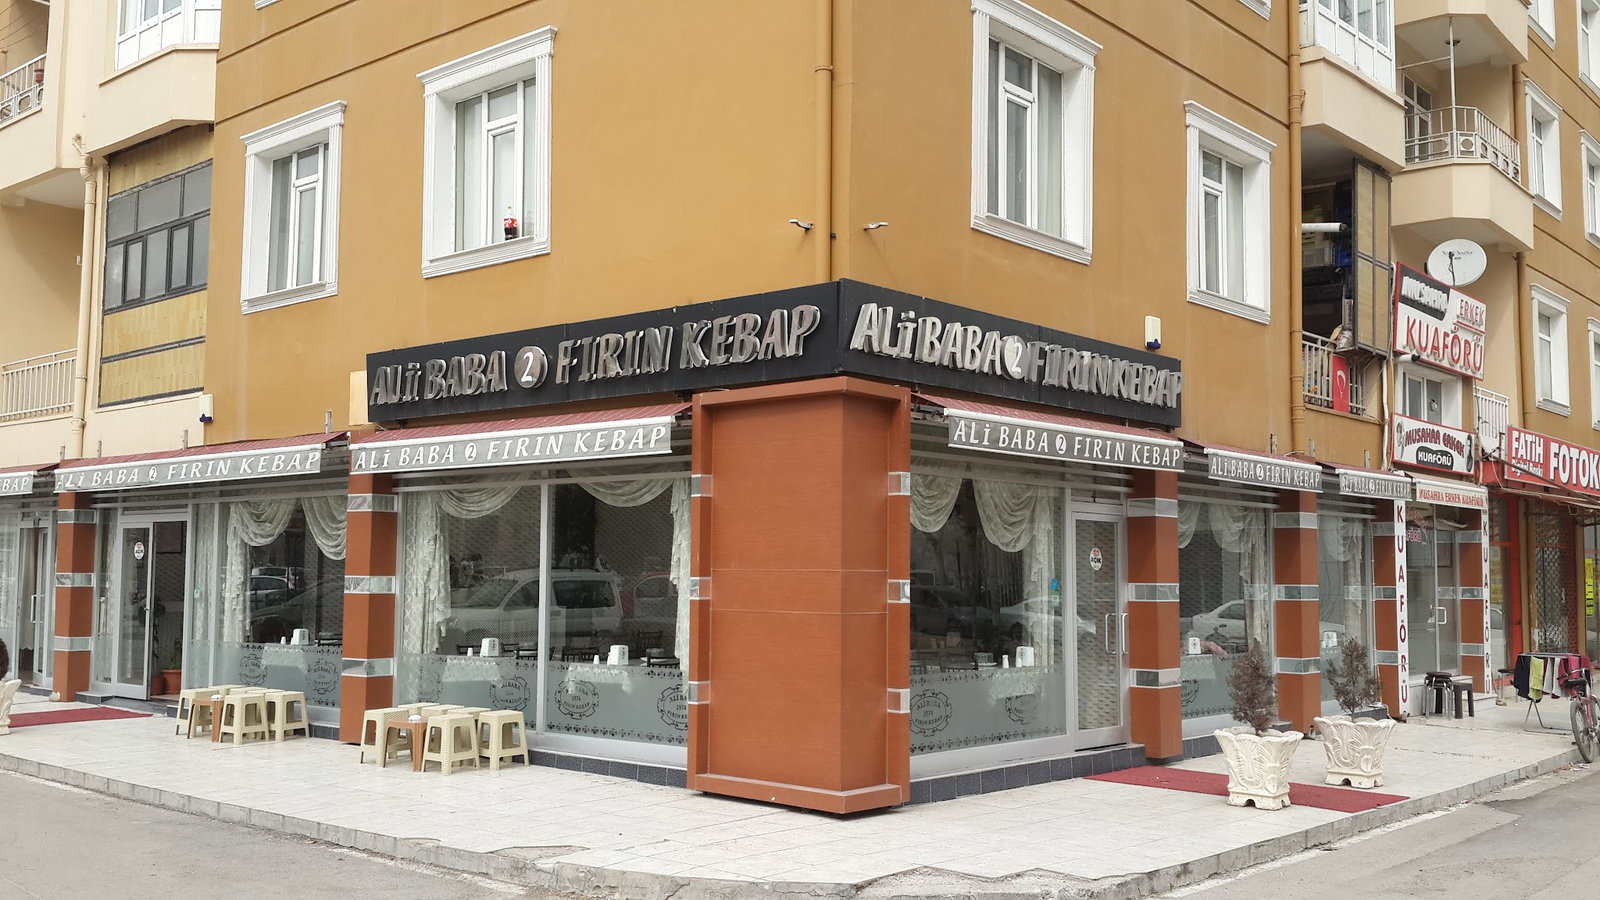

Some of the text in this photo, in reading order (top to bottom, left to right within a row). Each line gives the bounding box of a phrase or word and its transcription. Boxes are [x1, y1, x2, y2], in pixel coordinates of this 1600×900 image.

[1459, 299, 1485, 323] ERKEK
[424, 350, 507, 398] BABA
[555, 325, 673, 384] FIRIN
[679, 304, 821, 369] KEBAP
[914, 316, 1001, 376] BABA
[1024, 340, 1112, 396] FIRIN
[1108, 356, 1185, 409] KEBAP
[1406, 315, 1483, 372] KUAFÖRÜ
[398, 444, 454, 467] BABA
[487, 433, 564, 460] FIRIN
[574, 426, 667, 453] KEBAP
[998, 426, 1049, 453] BABA
[1073, 436, 1125, 461] FIRIN
[1131, 444, 1181, 467] KEBAP
[1405, 427, 1441, 447] MUSAHRA
[91, 468, 139, 486] BABA
[149, 467, 158, 481] 2
[167, 458, 233, 480] FIRIN
[238, 451, 322, 475] KEBAP
[1230, 461, 1255, 479] BABA
[1265, 466, 1292, 484] FIRIN
[1293, 470, 1320, 488] KEBAP
[1418, 451, 1452, 466] KUAFÖRÜ
[1549, 441, 1600, 490] FOTOK
[0, 477, 29, 492] BAP
[1396, 505, 1409, 704] KUAFÖRÜ
[1483, 521, 1491, 694] KUAFÖRÜ
